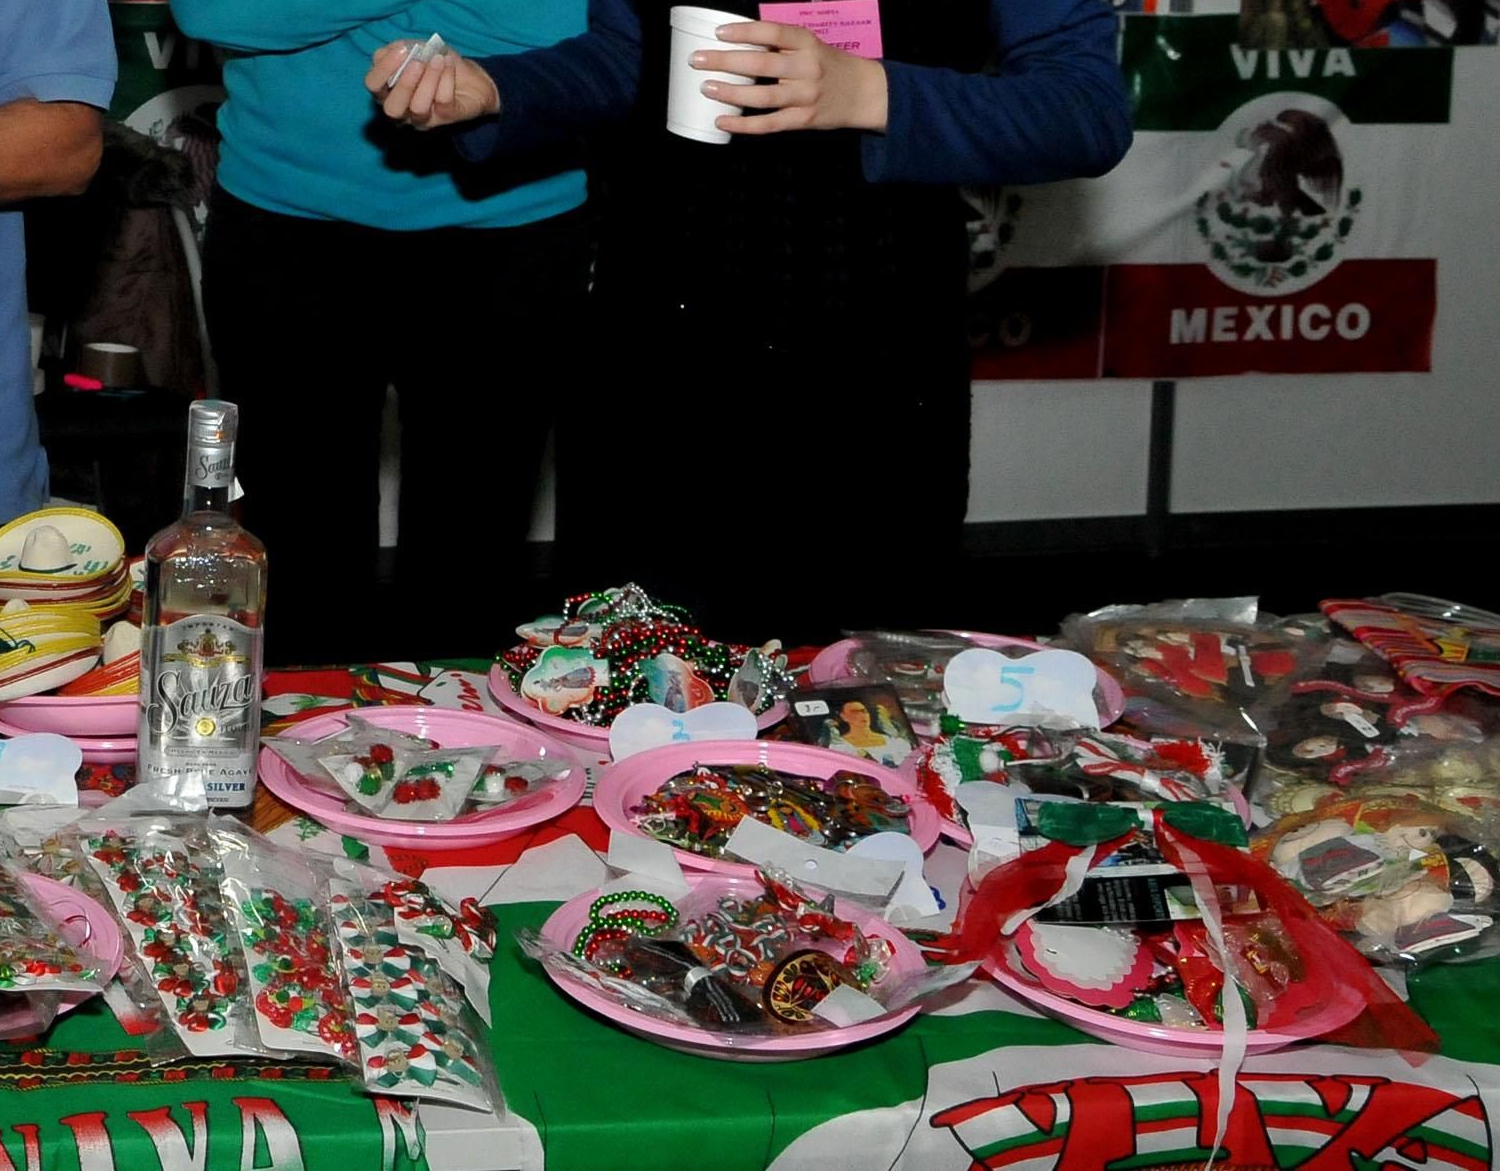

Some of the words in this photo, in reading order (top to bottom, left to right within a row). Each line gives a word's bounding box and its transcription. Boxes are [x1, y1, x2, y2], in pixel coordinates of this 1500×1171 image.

[1229, 42, 1357, 81] VIVA
[1169, 302, 1371, 345] MEXICO
[146, 669, 254, 734] Sauza
[990, 666, 1035, 713] 5
[207, 782, 246, 792] SILVER
